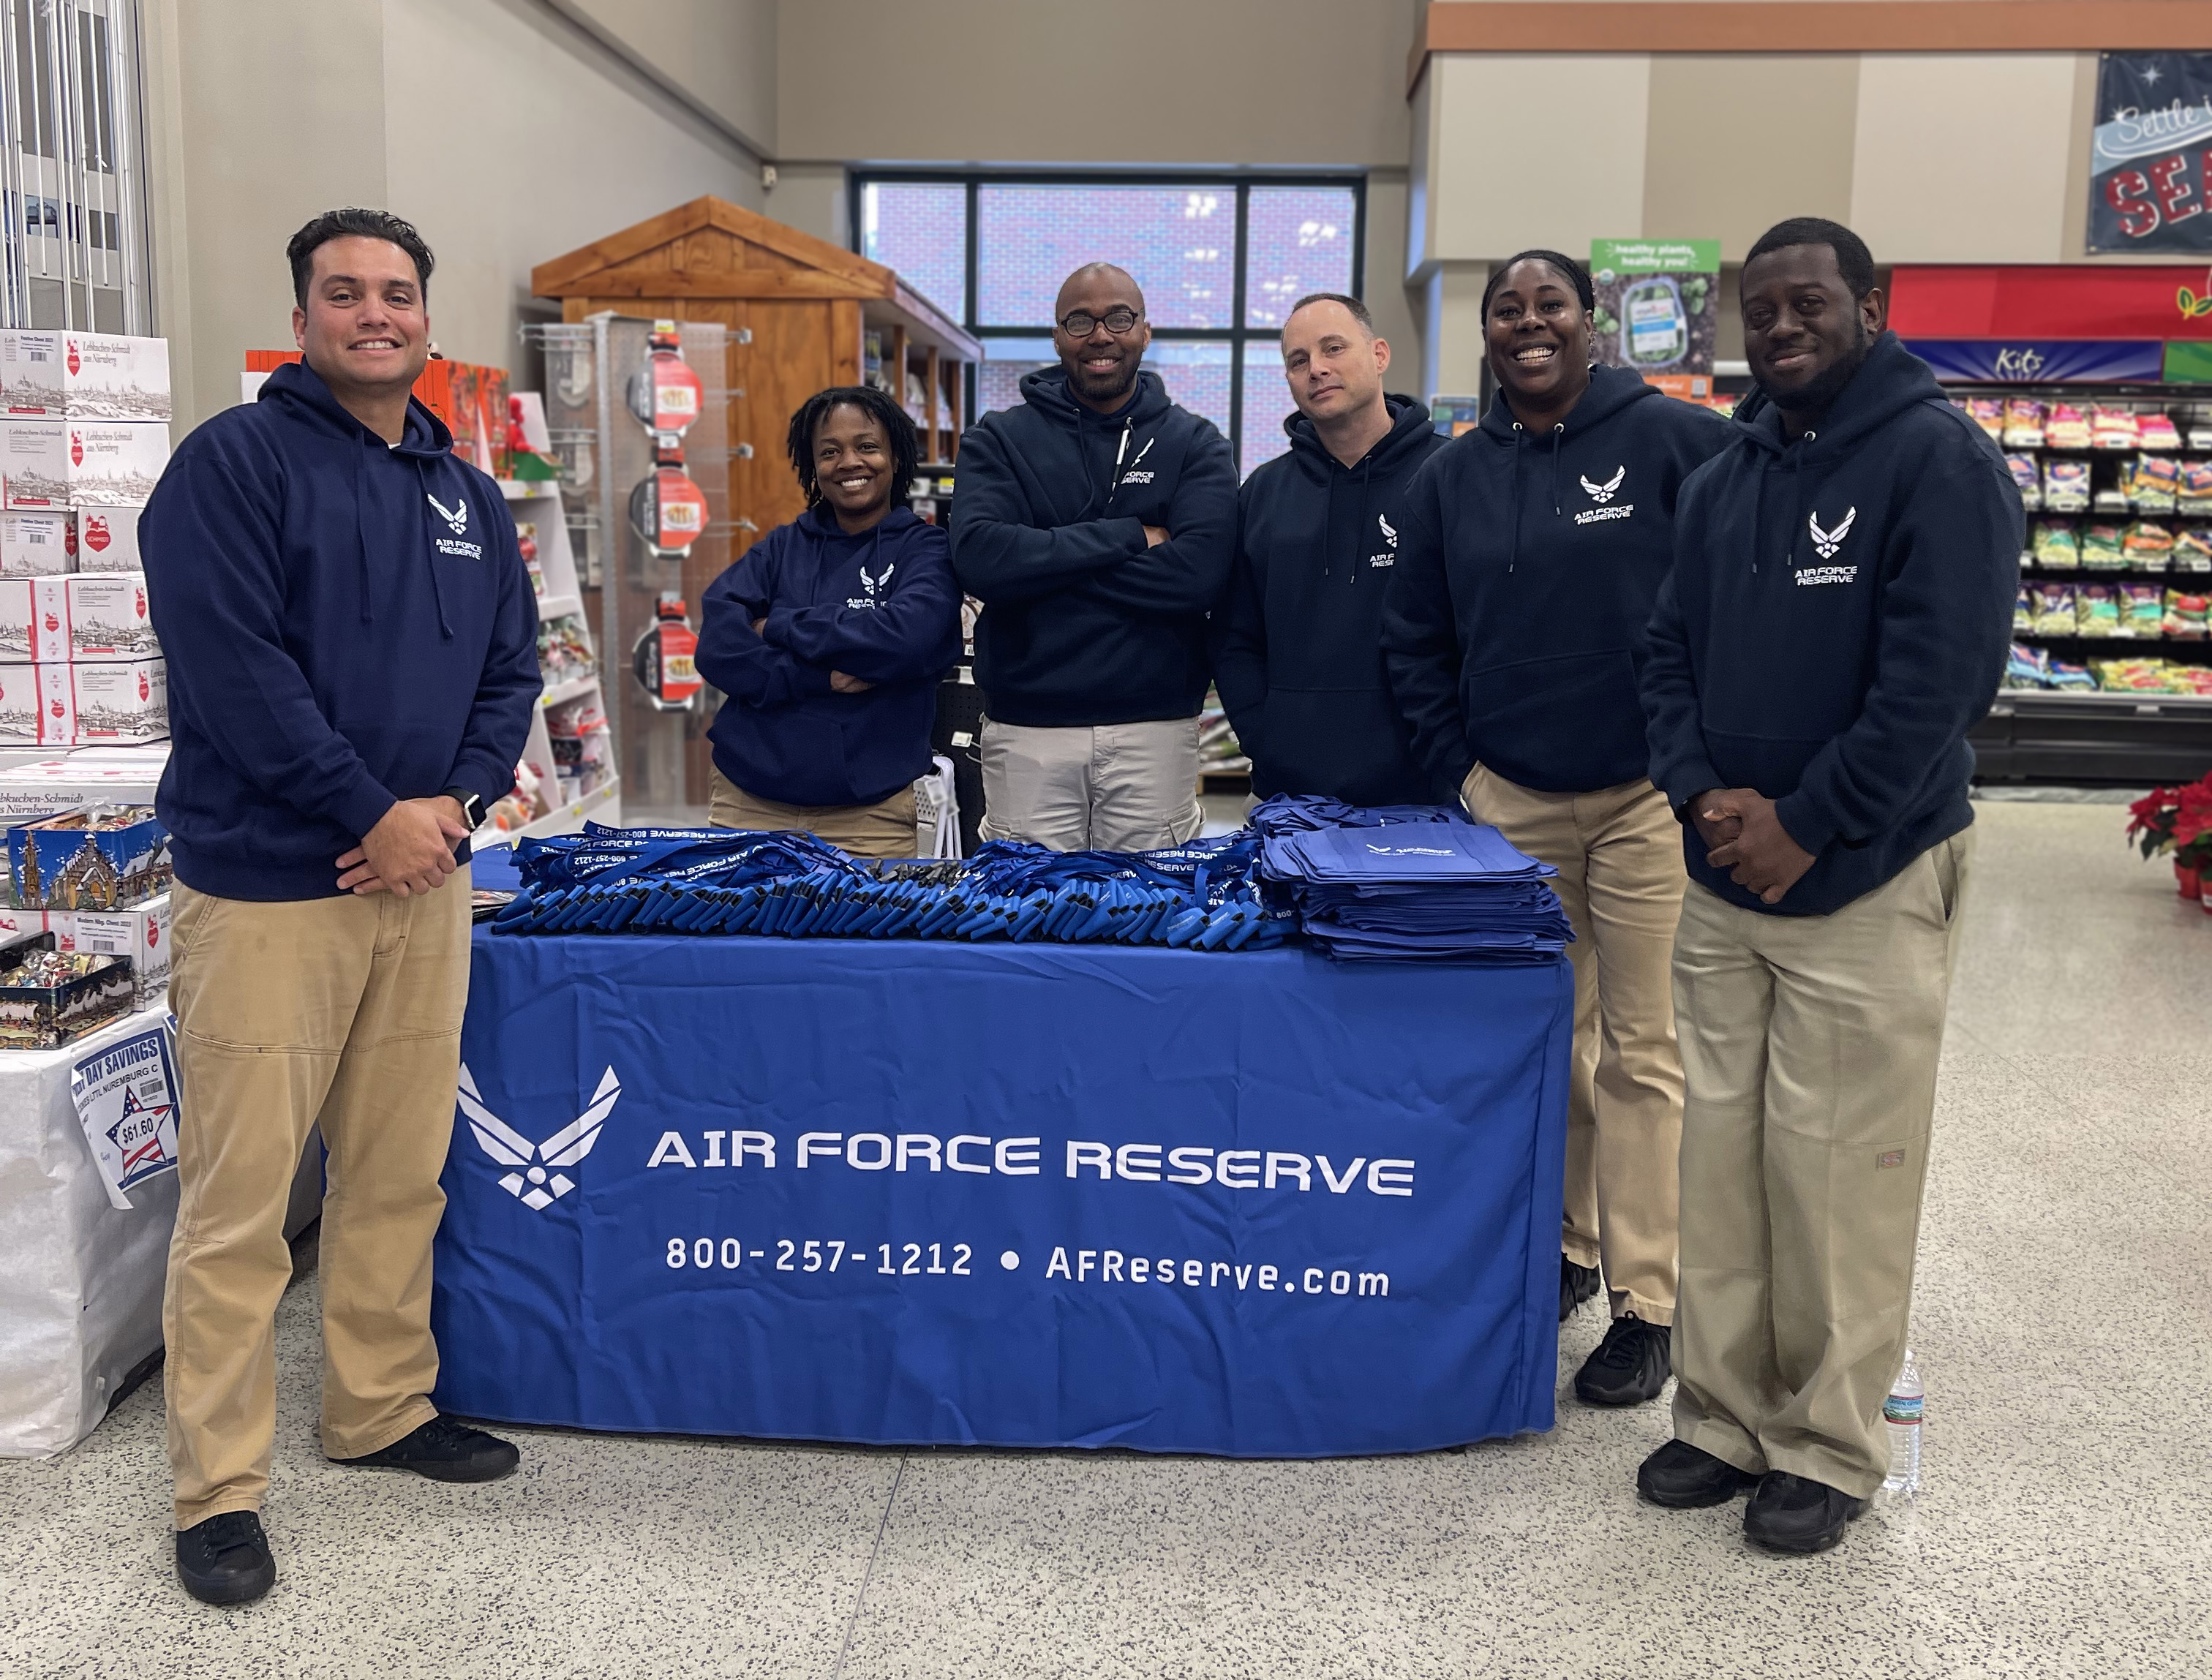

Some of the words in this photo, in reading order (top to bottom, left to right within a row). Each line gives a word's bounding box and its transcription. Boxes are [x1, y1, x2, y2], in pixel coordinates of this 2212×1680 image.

[2118, 98, 2200, 143] Settle
[1615, 244, 1656, 256] healthy
[1621, 256, 1662, 268] healthy
[1995, 347, 2044, 373] Kits
[1574, 510, 1594, 520] AIR
[1595, 505, 1633, 516] FORCE
[1577, 511, 1630, 525] RESERVE
[436, 538, 454, 547] AIR
[455, 540, 482, 554] FORCE
[439, 546, 481, 560] RESERVE
[1369, 554, 1387, 562] AIR
[1794, 568, 1816, 578] AIR
[1817, 565, 1858, 576] FORCE
[1797, 575, 1854, 586] RESERVE
[0, 792, 83, 803] bkuchen-Schmidt
[596, 826, 647, 839] 800-257-1212
[650, 829, 707, 839] RESERVE
[592, 840, 633, 848] FORCE
[573, 855, 626, 865] 800-257-1212
[727, 850, 748, 863] AIR
[1144, 850, 1186, 859] RESER
[686, 858, 726, 875] FORCE
[1144, 859, 1195, 872] RESERVE
[85, 1060, 103, 1086] DAY
[105, 1039, 158, 1076] SAVINGS
[102, 1067, 149, 1094] NUREMBURG
[151, 1063, 159, 1073] C
[122, 1117, 154, 1146] $61.60
[646, 1130, 776, 1169] AIR
[797, 1131, 1040, 1175] FORCE
[1066, 1140, 1415, 1197] RESERVE
[666, 1237, 973, 1276] 800-257-1212
[1045, 1246, 1390, 1297] AFReserve.com
